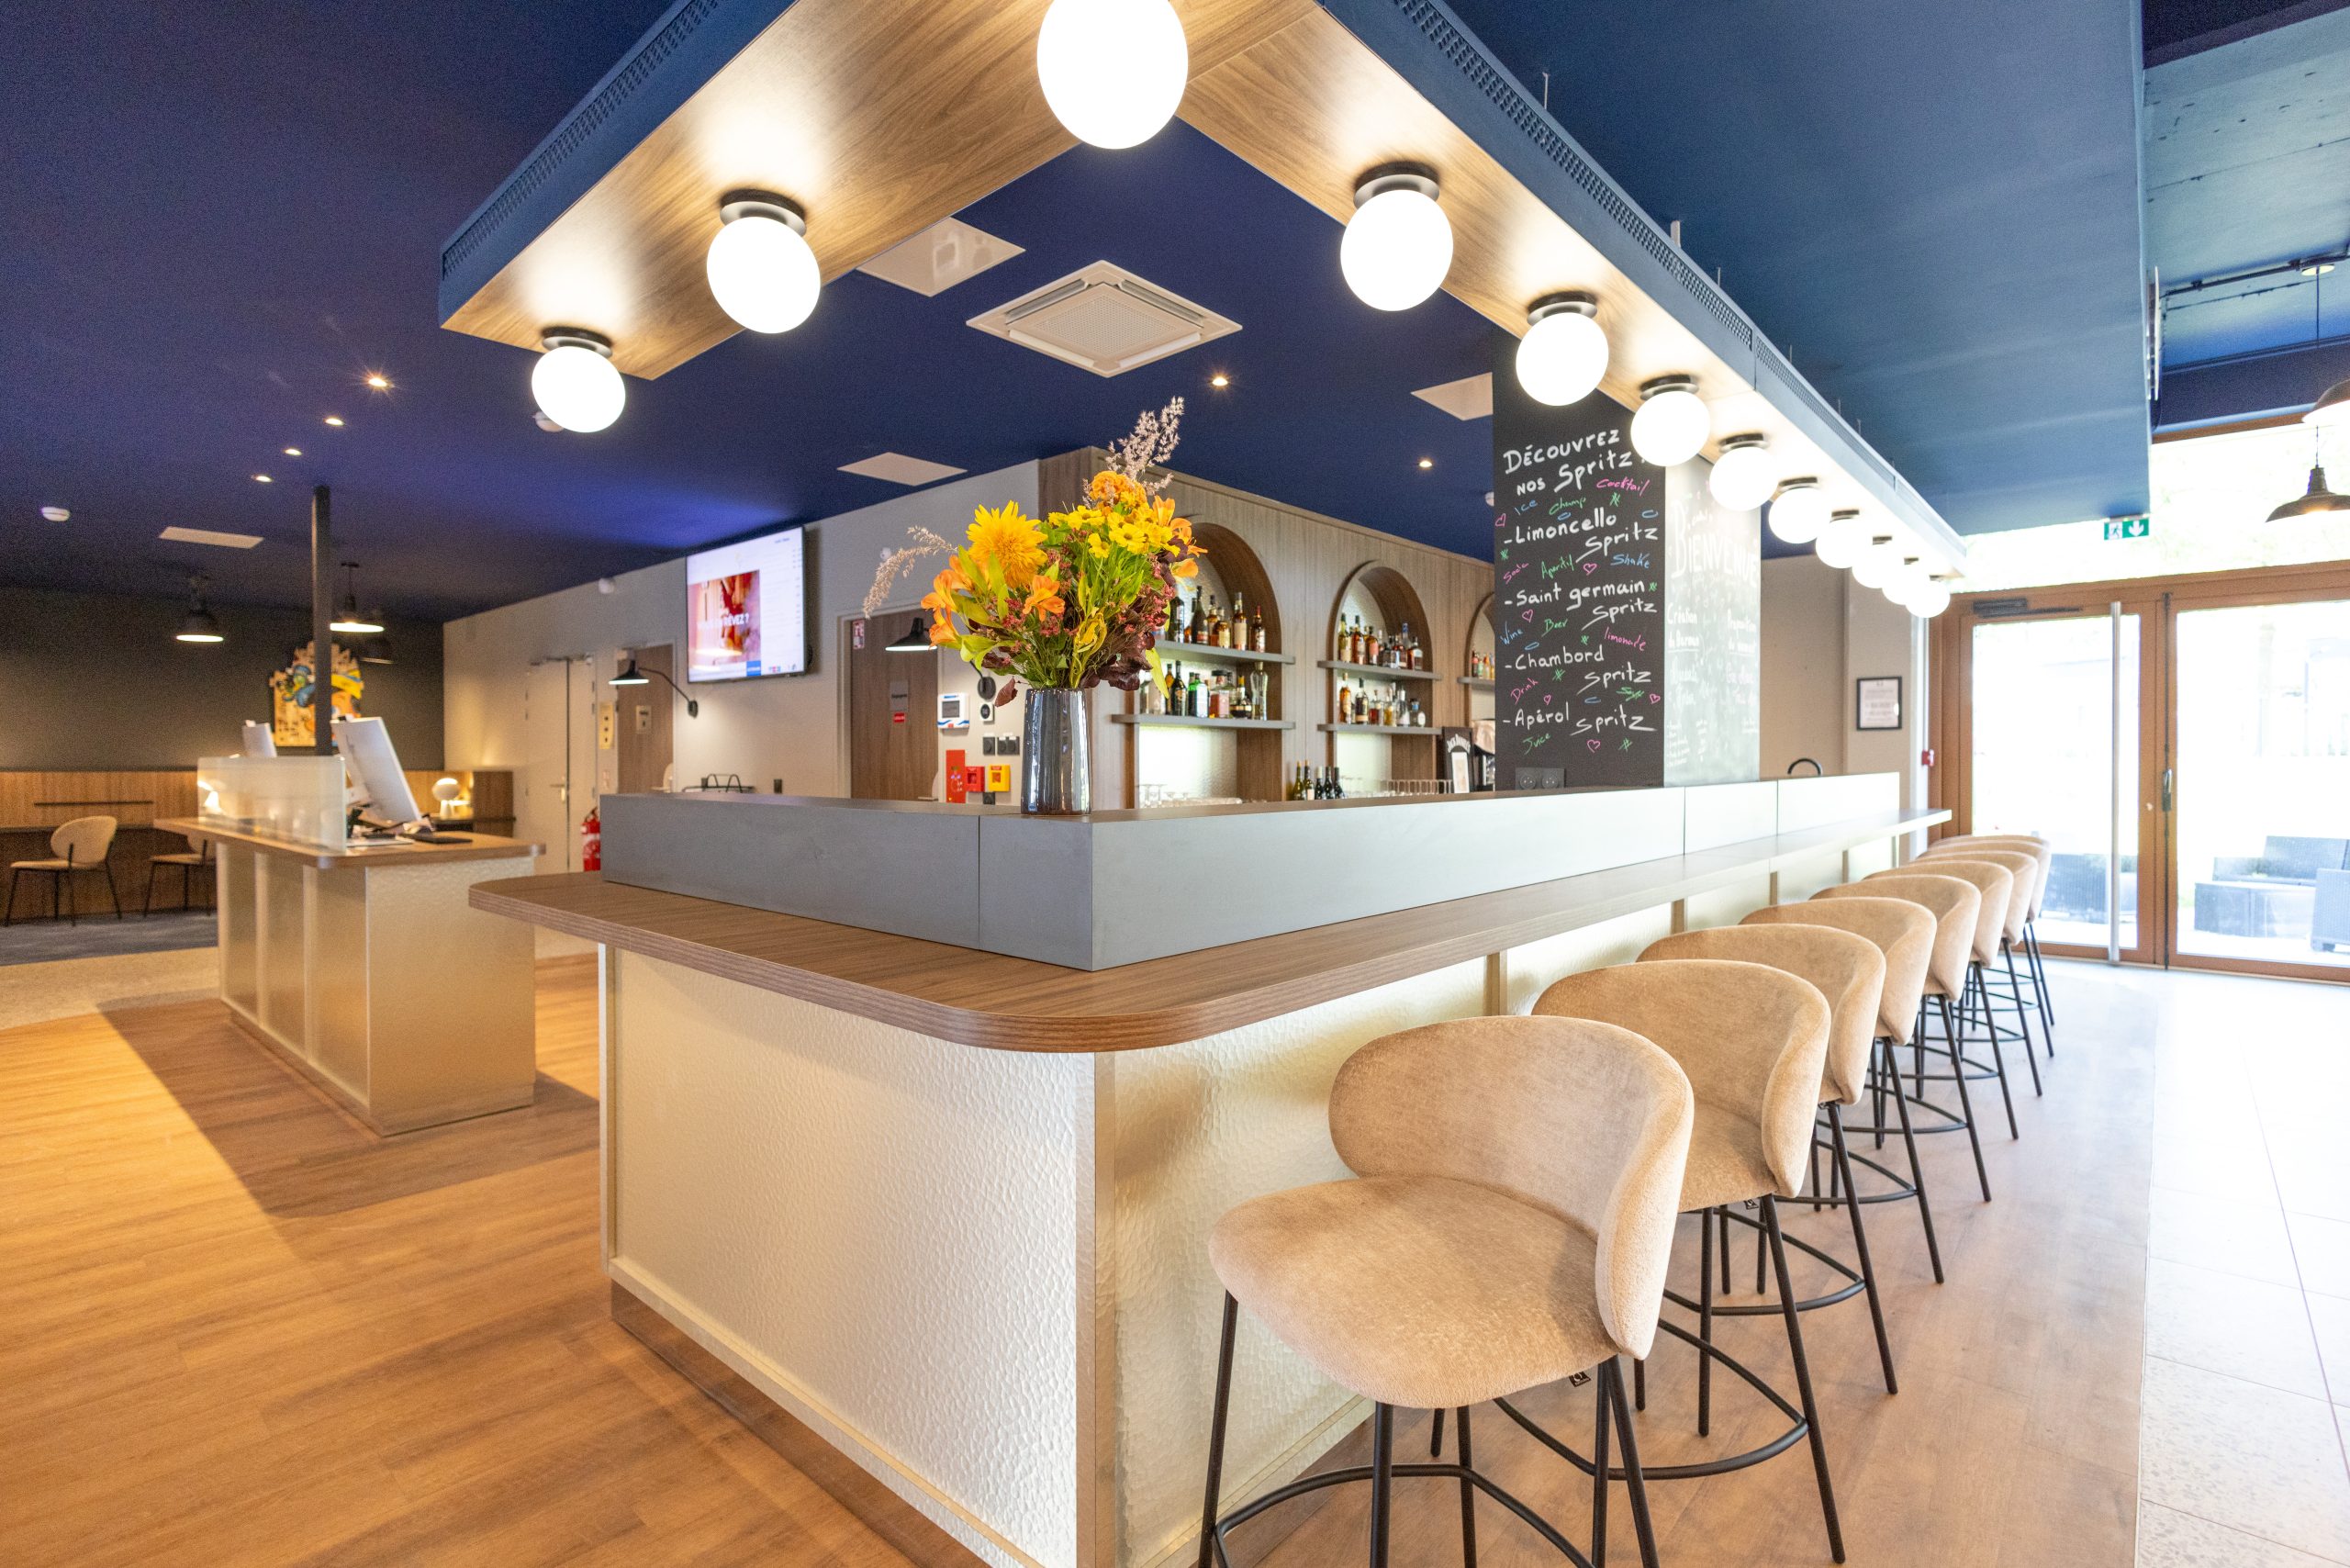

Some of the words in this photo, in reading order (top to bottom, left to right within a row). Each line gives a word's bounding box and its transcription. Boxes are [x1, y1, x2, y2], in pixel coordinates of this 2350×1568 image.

[1553, 449, 1633, 493] Spritz
[1596, 476, 1651, 497] Cocktail
[1575, 521, 1659, 563] Spritz
[1566, 579, 1645, 611] germain
[1581, 597, 1658, 632] Spritz
[1499, 620, 1524, 645] Wine
[1510, 678, 1539, 705] Drink
[1576, 661, 1652, 695] Spritz
[1570, 704, 1658, 736] Spritz
[1522, 733, 1551, 755] Juice
